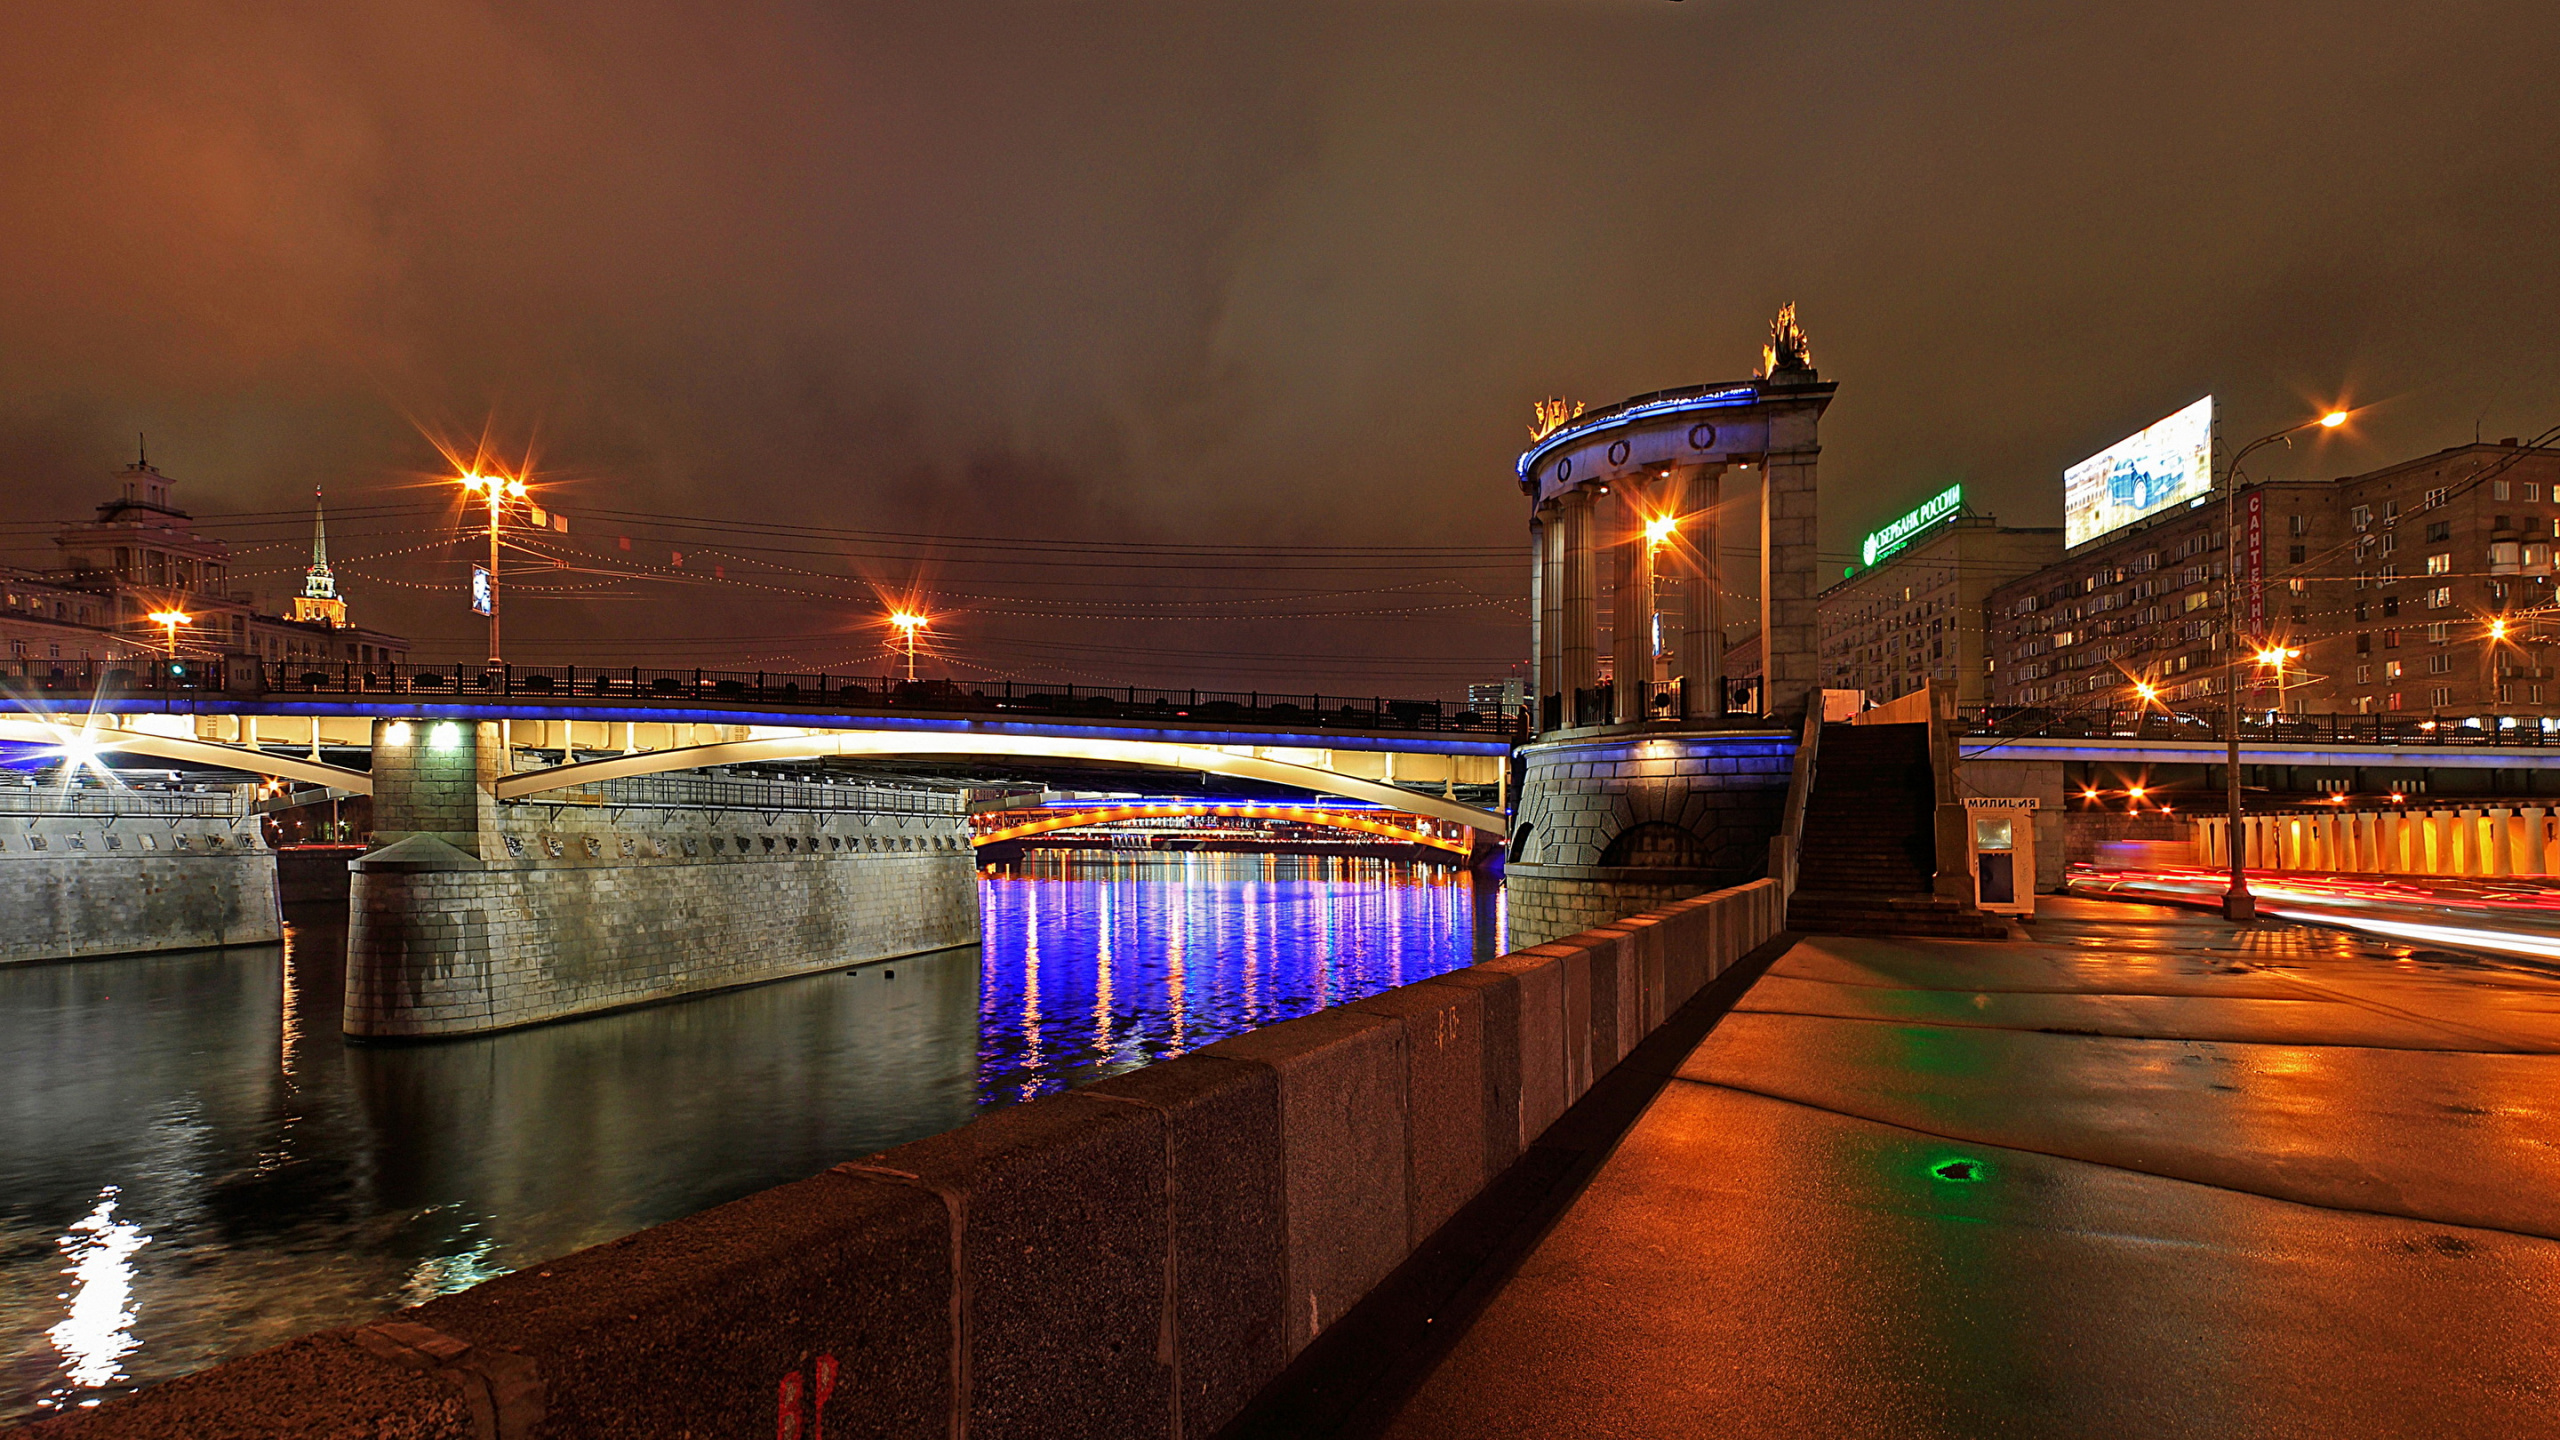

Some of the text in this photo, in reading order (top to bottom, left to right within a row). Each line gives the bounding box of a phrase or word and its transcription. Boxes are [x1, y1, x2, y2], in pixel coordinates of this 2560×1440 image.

[1876, 483, 1960, 549] СБЕРБАНК РОССИИ
[2249, 497, 2262, 668] САНТЕХНИК
